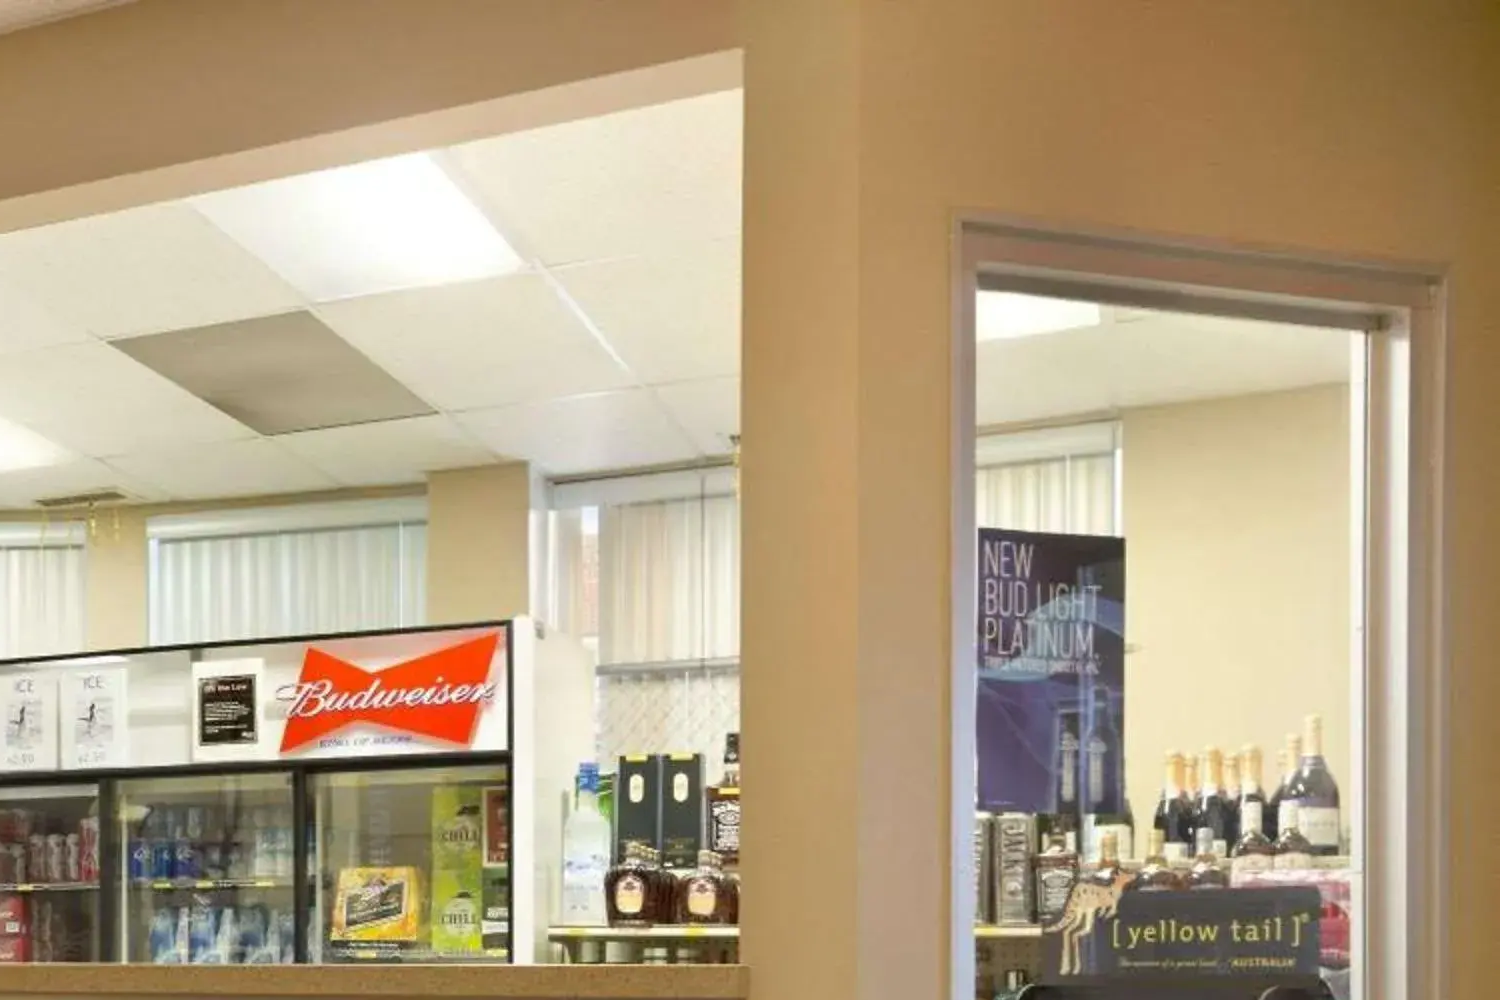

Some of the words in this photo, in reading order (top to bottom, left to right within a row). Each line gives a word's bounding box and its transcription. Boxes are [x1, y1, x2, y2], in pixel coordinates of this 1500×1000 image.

[984, 539, 1034, 578] NEW
[984, 578, 1028, 617] BUD
[1036, 581, 1103, 621] LIGHT
[276, 677, 498, 718] Budweiser
